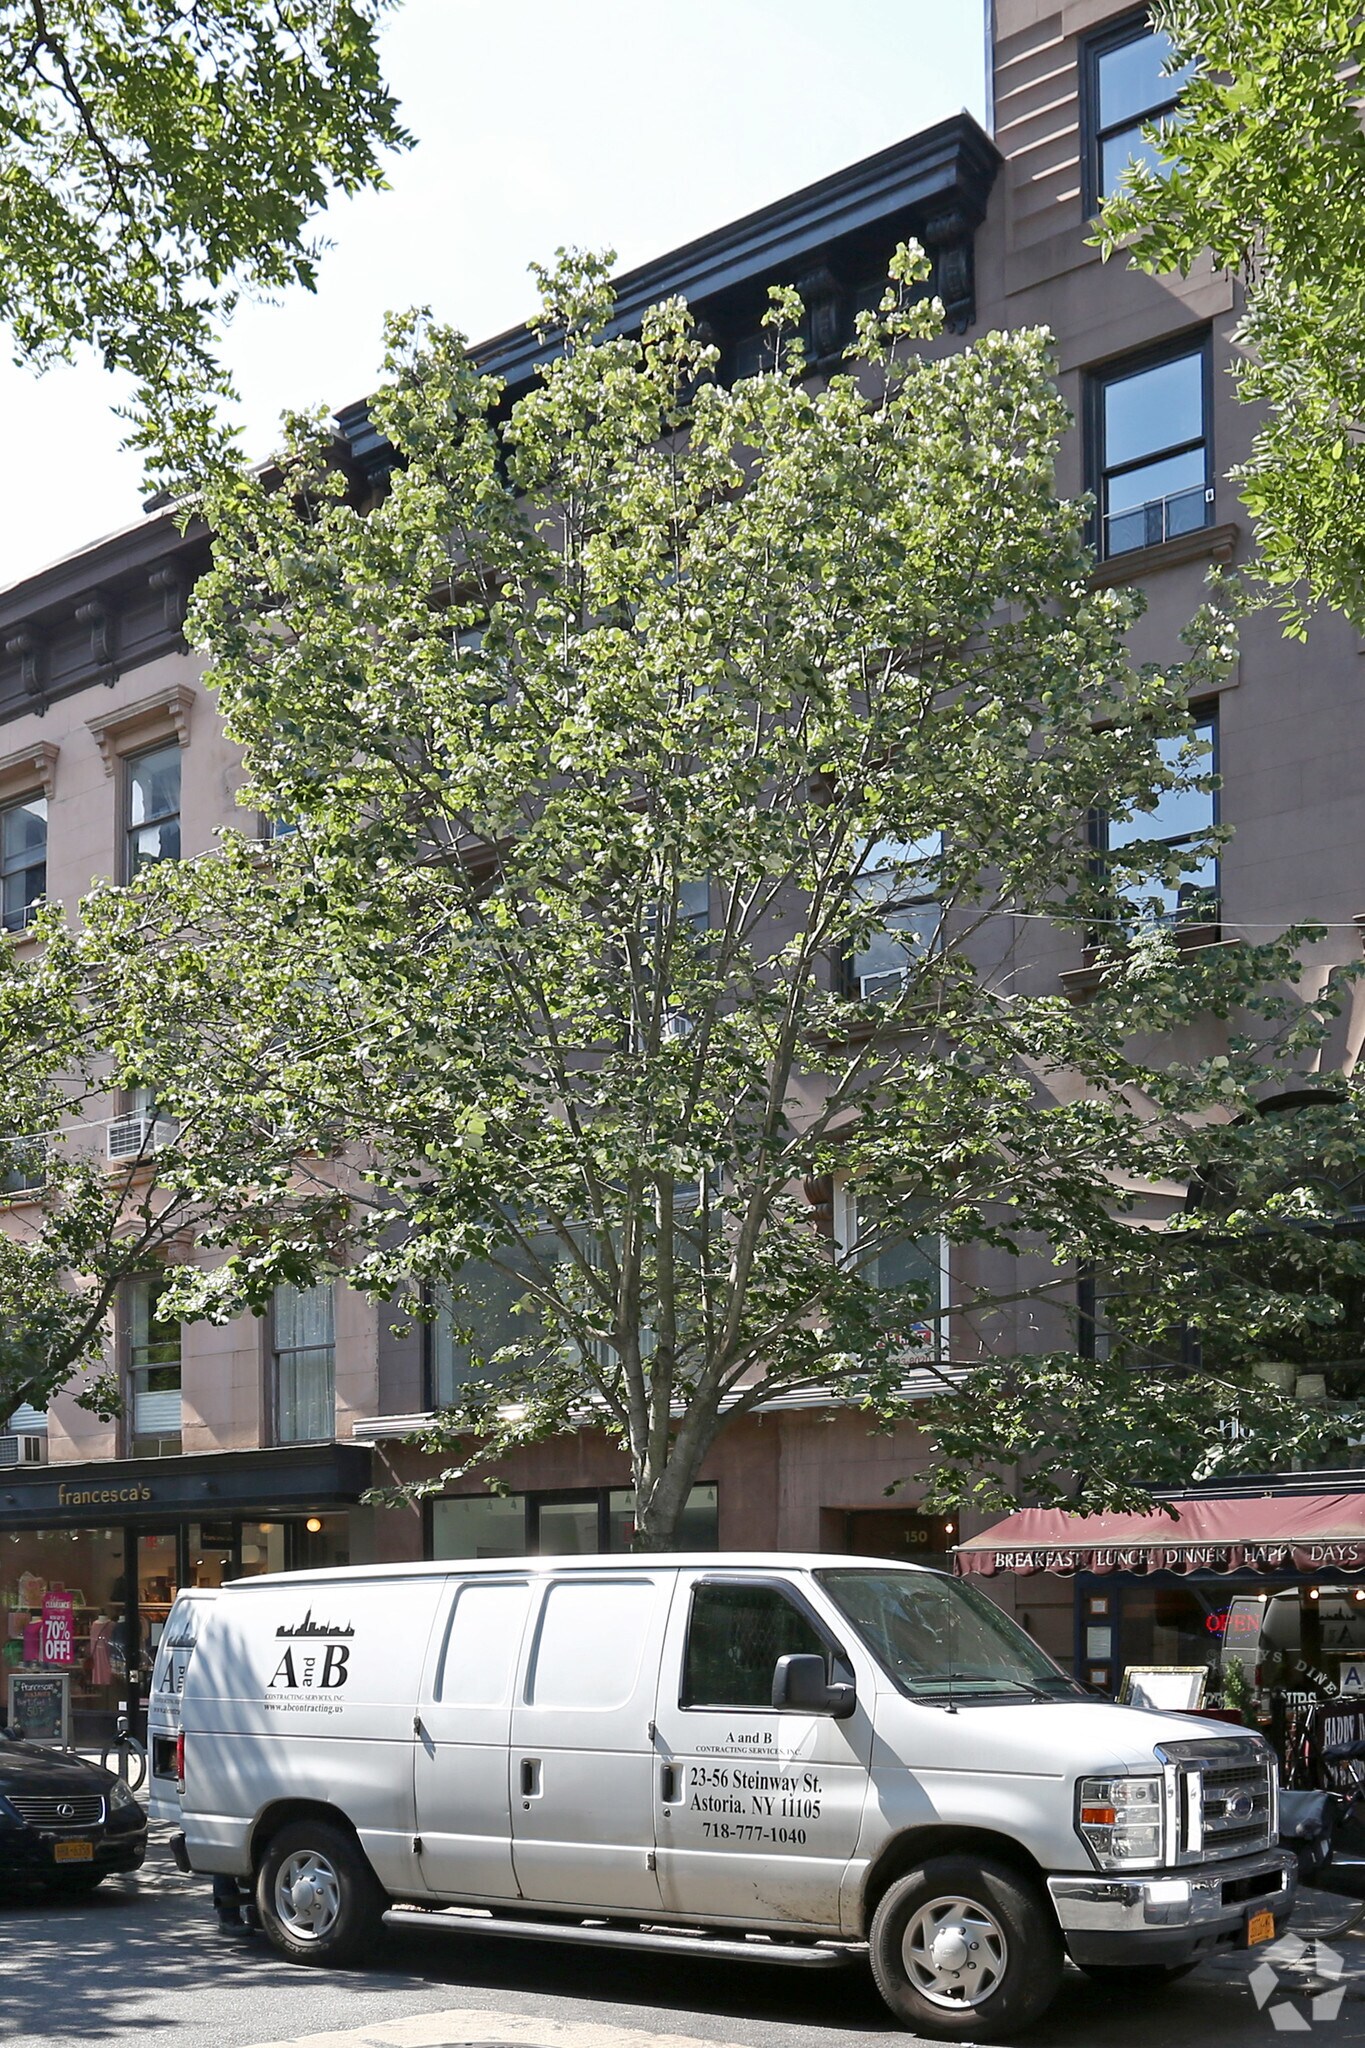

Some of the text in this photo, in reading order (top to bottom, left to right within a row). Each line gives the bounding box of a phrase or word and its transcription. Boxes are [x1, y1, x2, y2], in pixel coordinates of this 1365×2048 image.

[58, 1482, 151, 1505] francesca's
[904, 1531, 928, 1543] 150
[1097, 1550, 1154, 1566] LUNCH.
[1166, 1548, 1227, 1564] DINNER
[1244, 1544, 1297, 1562] HAPPY
[1310, 1544, 1359, 1561] DAYS
[45, 1620, 71, 1640] 70%
[1205, 1614, 1261, 1632] OPEN
[45, 1640, 71, 1660] OFF!
[266, 1644, 350, 1688] A and B
[1344, 1666, 1362, 1685] A
[1295, 1660, 1338, 1695] DINE
[264, 1693, 304, 1701] CONTRACTING
[264, 1703, 343, 1714] www.abcontracting.us
[725, 1732, 772, 1744] A and B
[695, 1745, 748, 1754] CONTRACTING
[690, 1767, 823, 1793] 23-56 Steinway St.
[751, 1796, 776, 1816] NY
[781, 1798, 821, 1819] 11105
[702, 1822, 807, 1845] 718-777-1040
